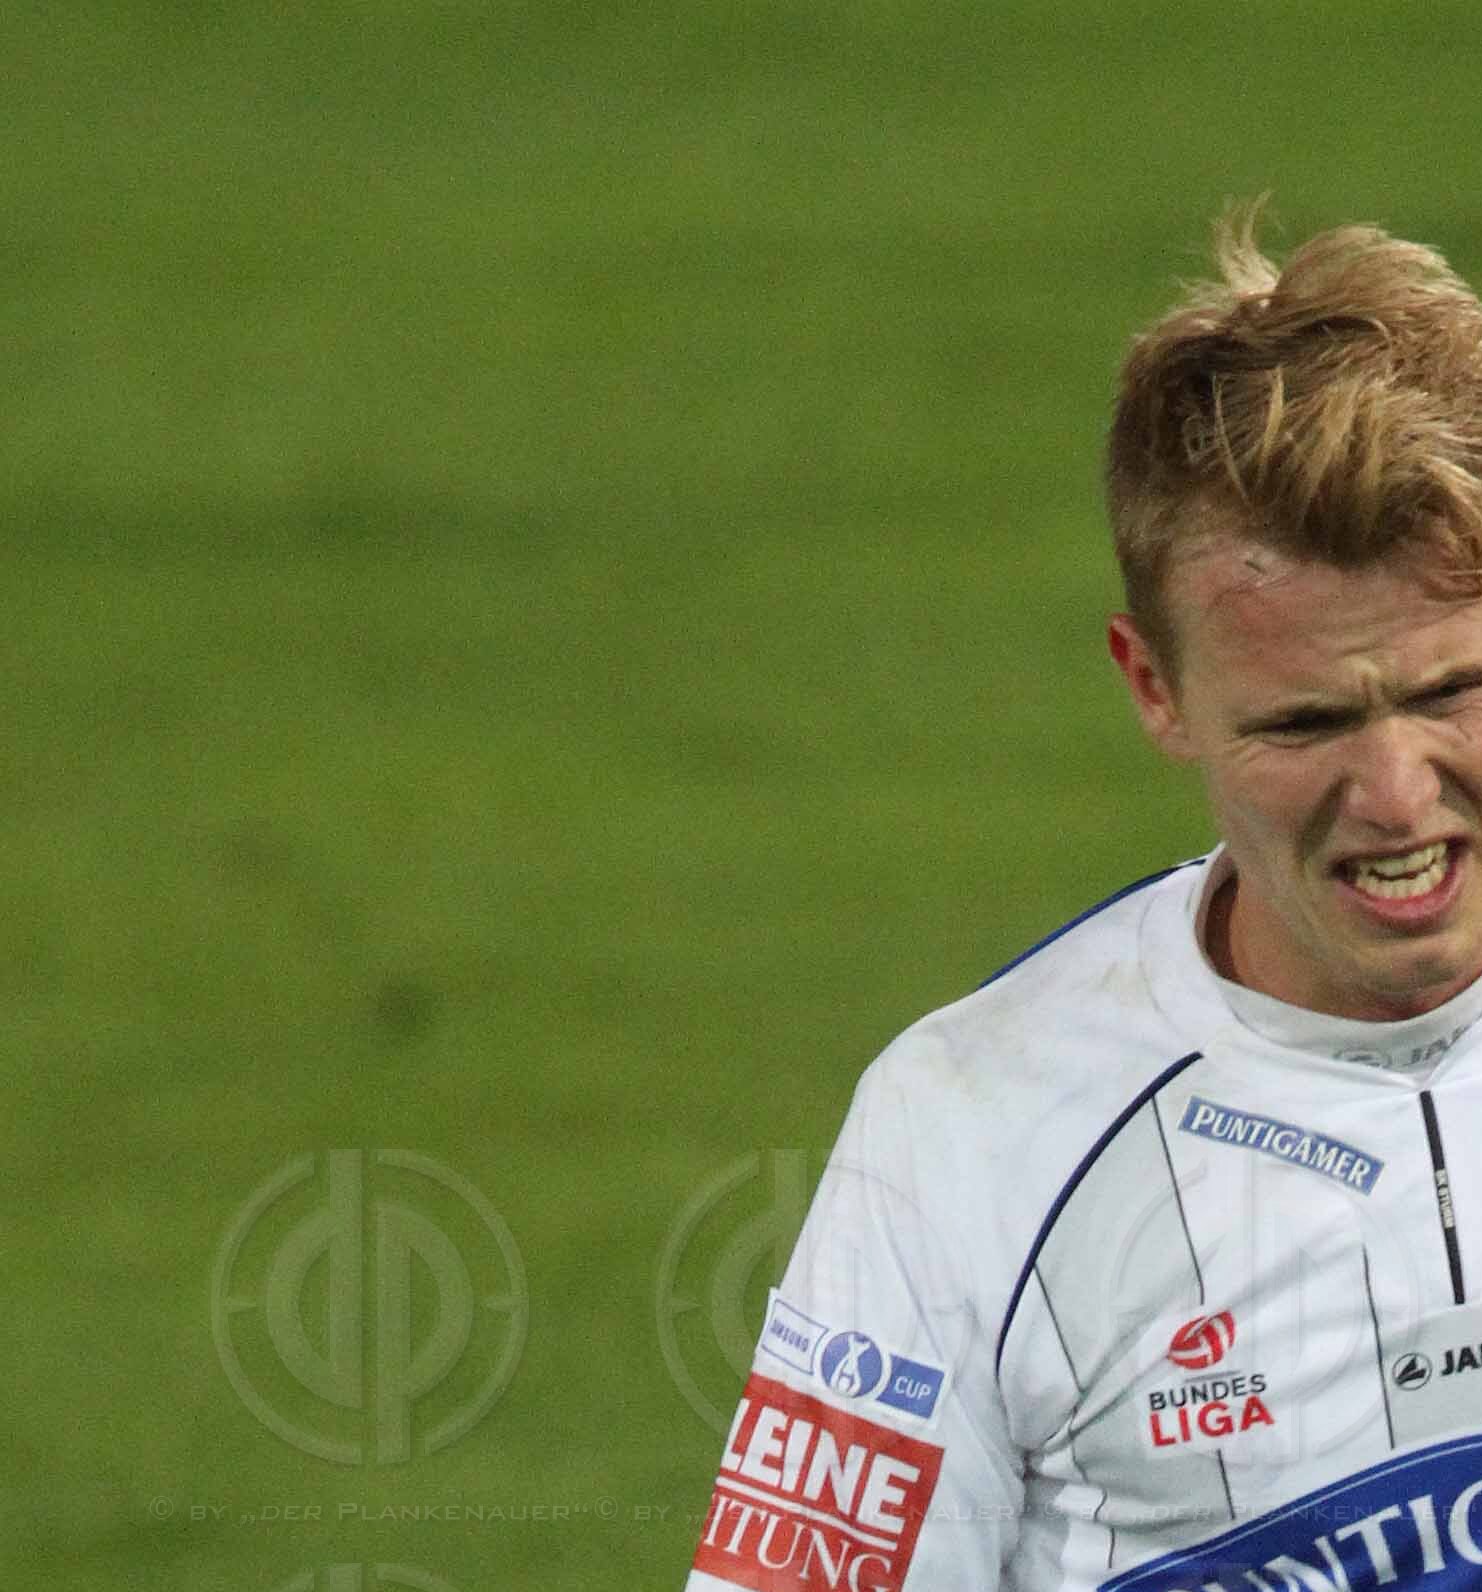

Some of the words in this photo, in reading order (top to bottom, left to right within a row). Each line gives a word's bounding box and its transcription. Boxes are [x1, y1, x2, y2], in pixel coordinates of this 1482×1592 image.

[1191, 1110, 1372, 1187] PUNTIGAMER
[893, 1374, 933, 1399] CUP
[1149, 1374, 1267, 1411] BUNDES
[1149, 1396, 1275, 1448] LIGA
[720, 1398, 921, 1535] LEINE
